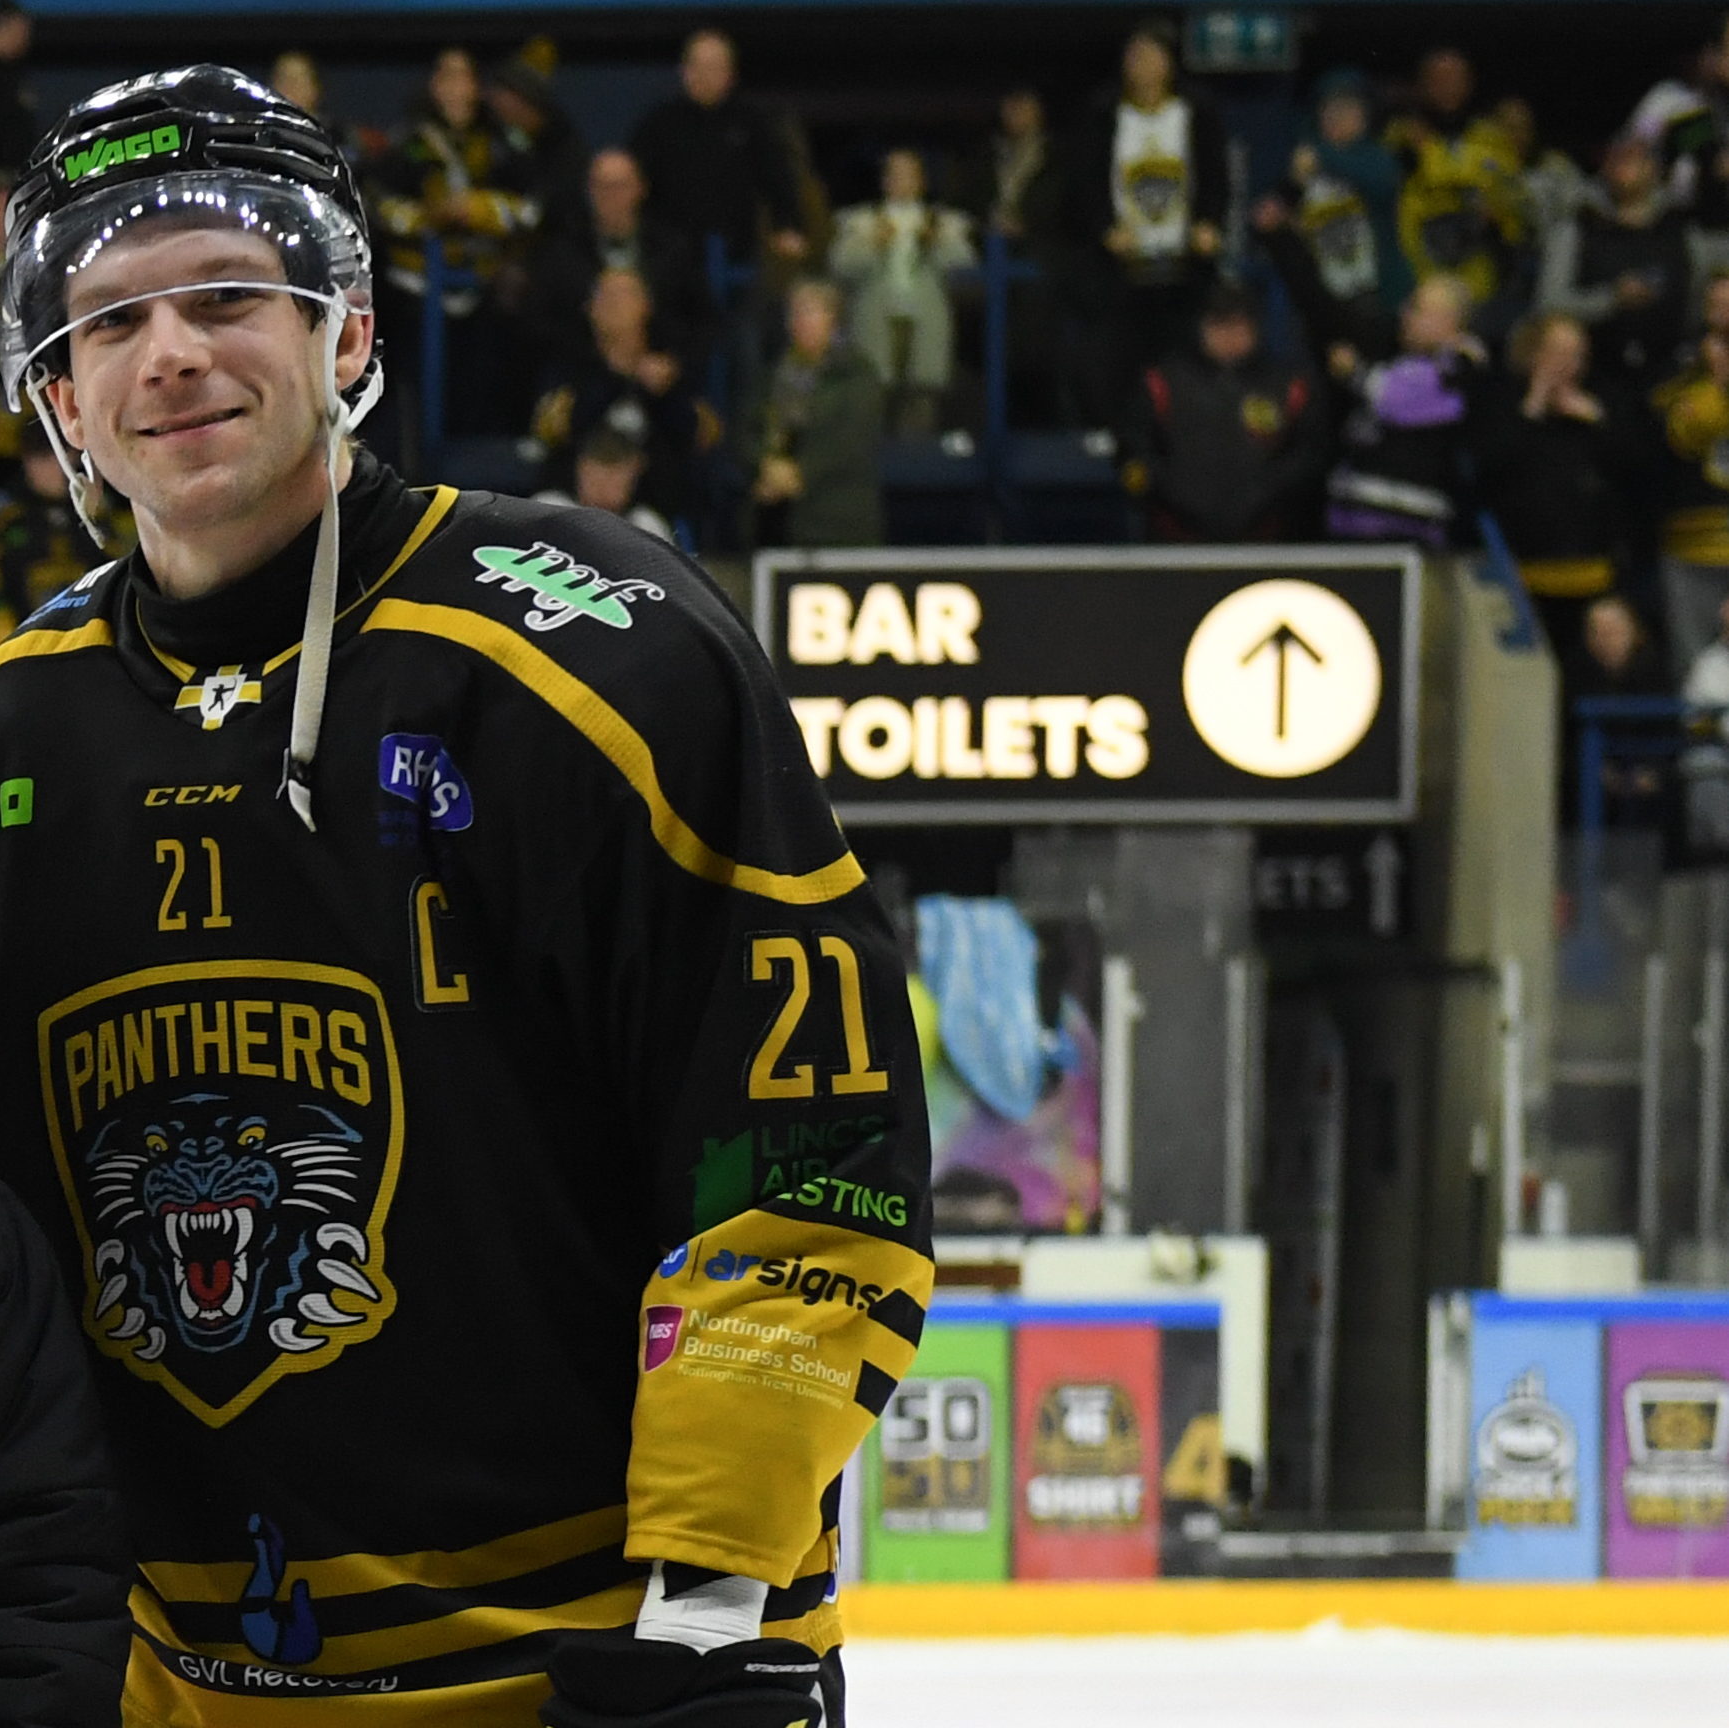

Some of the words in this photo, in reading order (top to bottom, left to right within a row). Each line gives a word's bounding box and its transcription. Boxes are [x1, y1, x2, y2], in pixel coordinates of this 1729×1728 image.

[64, 124, 181, 182] WAGO
[788, 582, 982, 665] BAR
[789, 695, 1150, 779] TOILETS
[144, 784, 242, 807] CCM
[155, 836, 232, 931] 21
[416, 881, 470, 1004] C
[748, 936, 889, 1100] 21
[65, 1000, 372, 1132] PANTHERS
[775, 1174, 907, 1227] STING
[705, 1247, 884, 1312] arsigns
[688, 1308, 818, 1351] Nottingham
[683, 1336, 784, 1369] Business
[789, 1353, 852, 1389] School
[179, 1655, 235, 1687] GVL
[244, 1665, 398, 1691] Recovery
